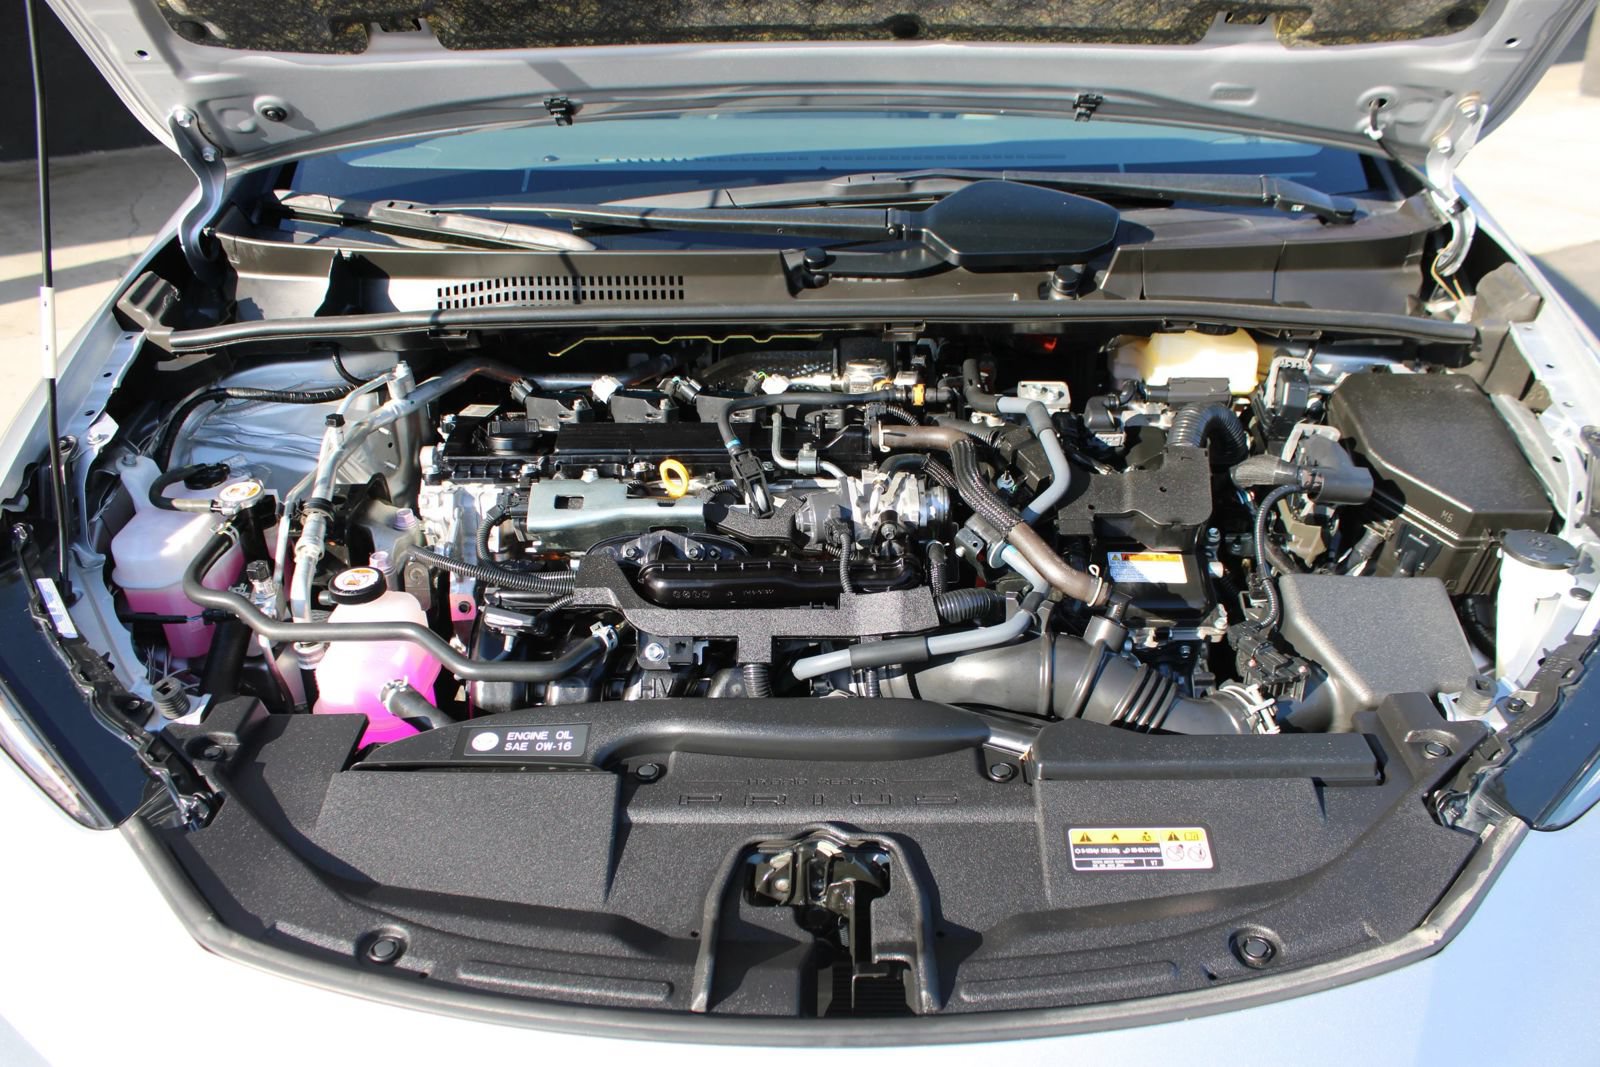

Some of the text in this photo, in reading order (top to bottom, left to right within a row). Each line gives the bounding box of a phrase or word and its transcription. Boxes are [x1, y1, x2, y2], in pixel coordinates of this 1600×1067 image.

[506, 730, 574, 741] ENGINE OIL
[504, 741, 572, 751] SAE 0W-16
[678, 792, 958, 806] PRIUS
